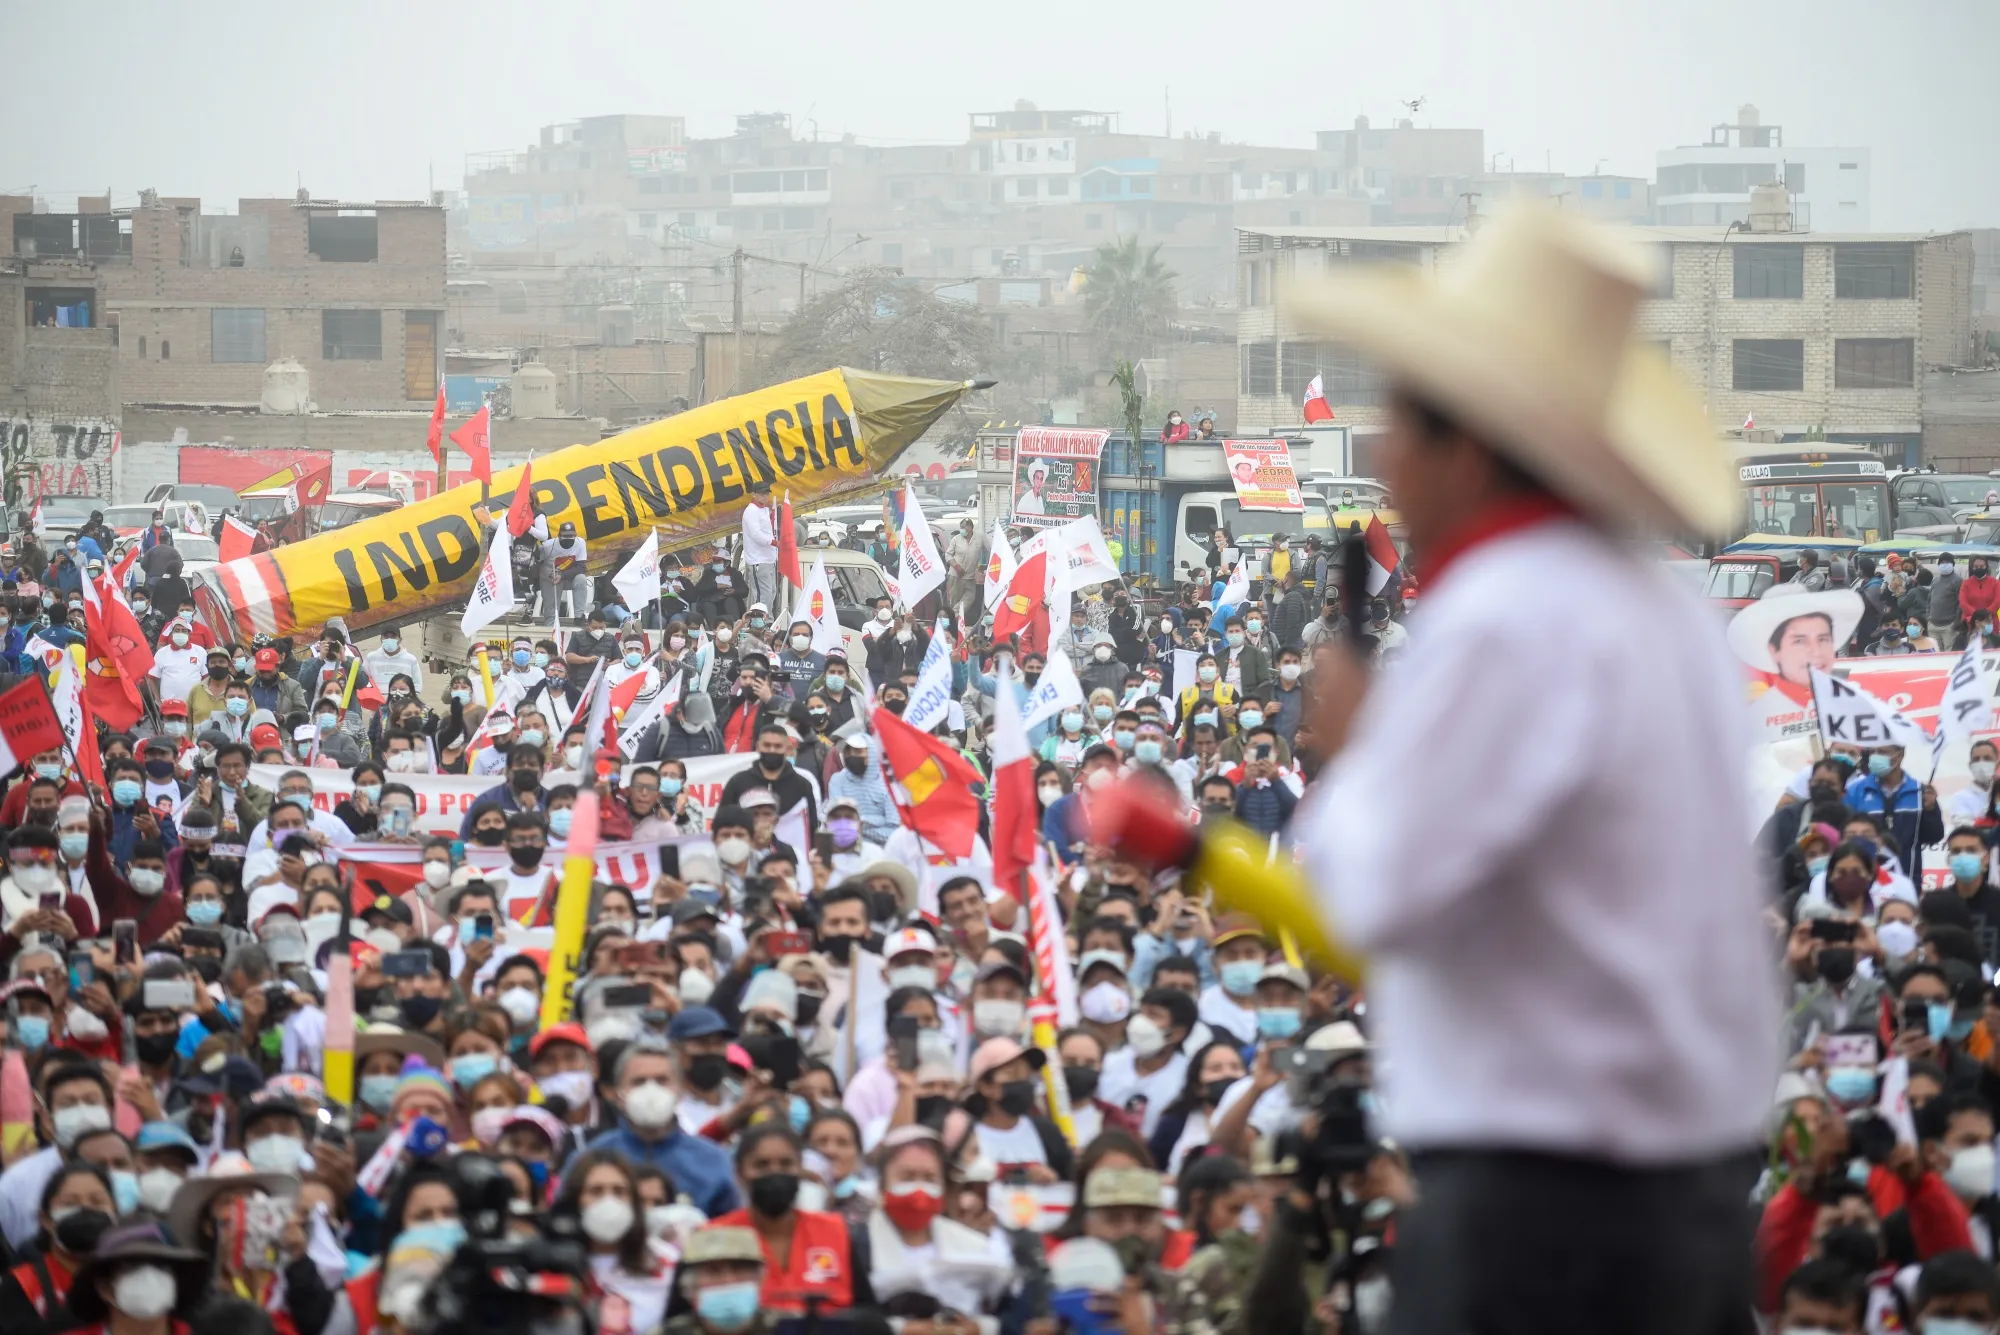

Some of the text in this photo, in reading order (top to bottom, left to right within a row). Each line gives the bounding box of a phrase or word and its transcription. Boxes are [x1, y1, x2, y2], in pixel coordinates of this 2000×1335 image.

[1054, 462, 1072, 474] Marca
[1255, 468, 1292, 476] PEDRO
[1741, 466, 1769, 479] CALLAO
[1066, 504, 1079, 514] 2021
[1720, 564, 1758, 572] NICOLAS
